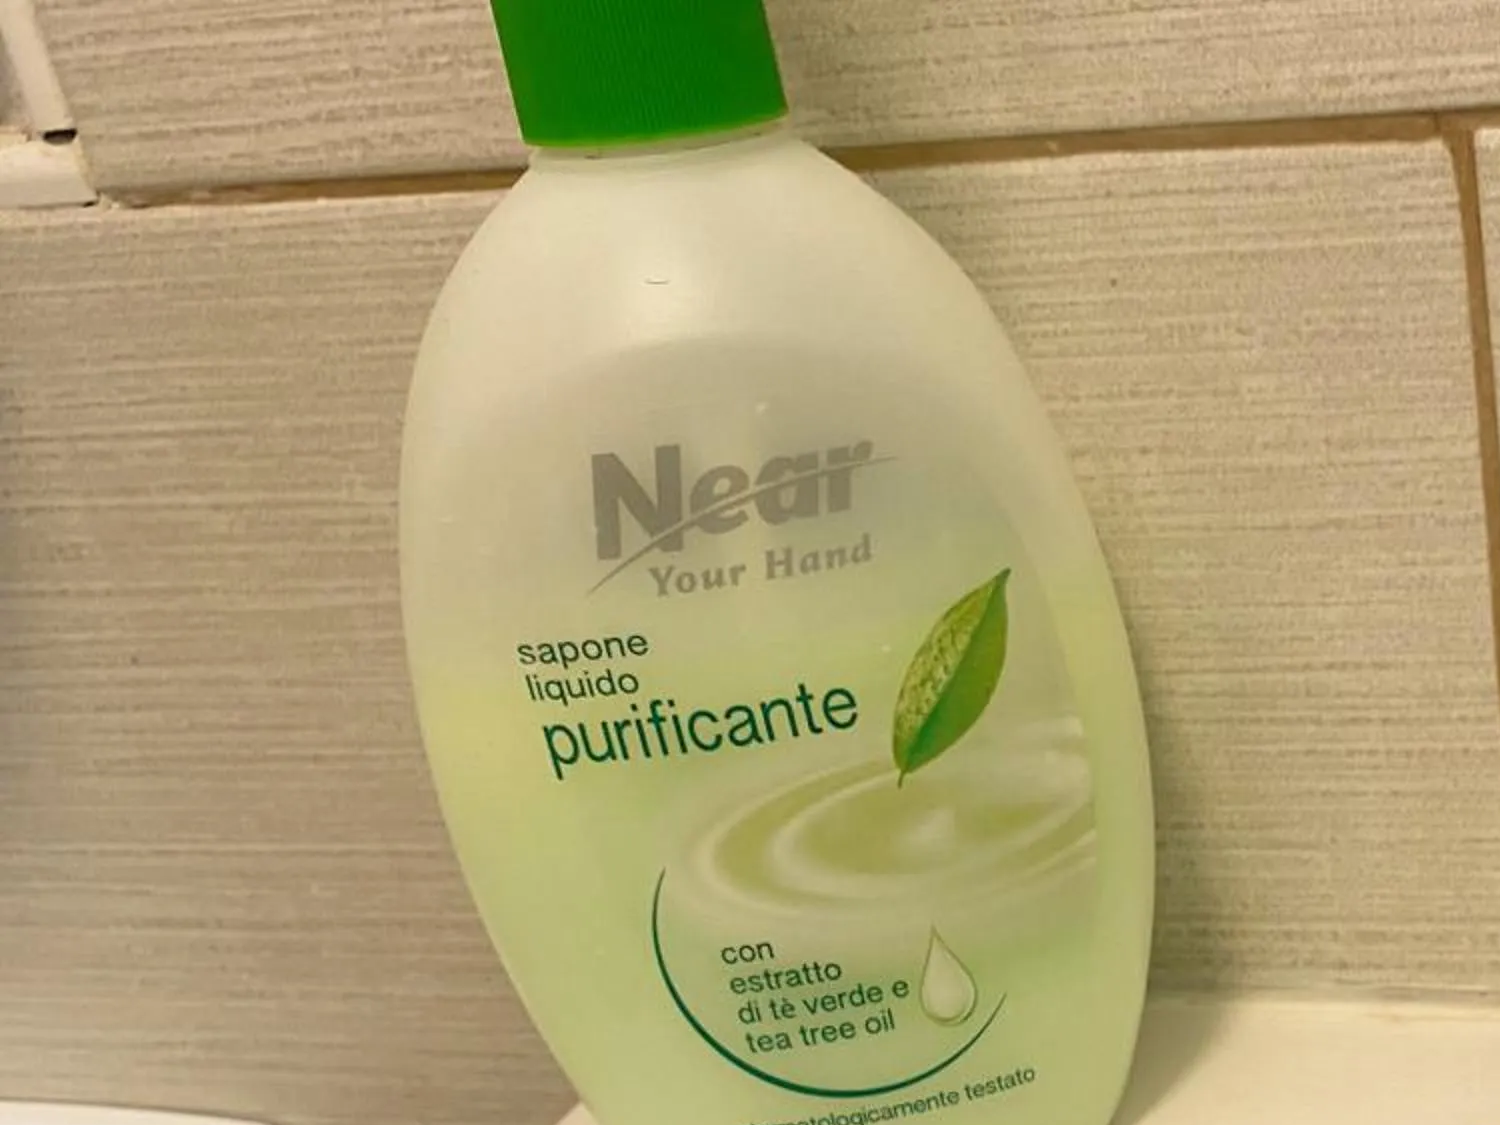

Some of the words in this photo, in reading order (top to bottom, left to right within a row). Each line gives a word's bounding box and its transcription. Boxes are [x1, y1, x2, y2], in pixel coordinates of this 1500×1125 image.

[591, 441, 874, 560] Near
[649, 562, 746, 597] Your
[765, 533, 873, 581] Hand
[517, 633, 649, 668] sapone
[526, 667, 640, 705] liquido
[543, 682, 858, 780] purificante
[721, 941, 774, 965] con
[730, 960, 842, 994] estratto
[738, 1002, 761, 1024] di
[769, 997, 796, 1020] tè
[803, 981, 883, 1015] verde
[892, 979, 910, 998] e
[746, 1031, 792, 1053] tea
[799, 1014, 856, 1047] tree
[865, 1008, 895, 1035] oil
[965, 1067, 1036, 1100] testato
